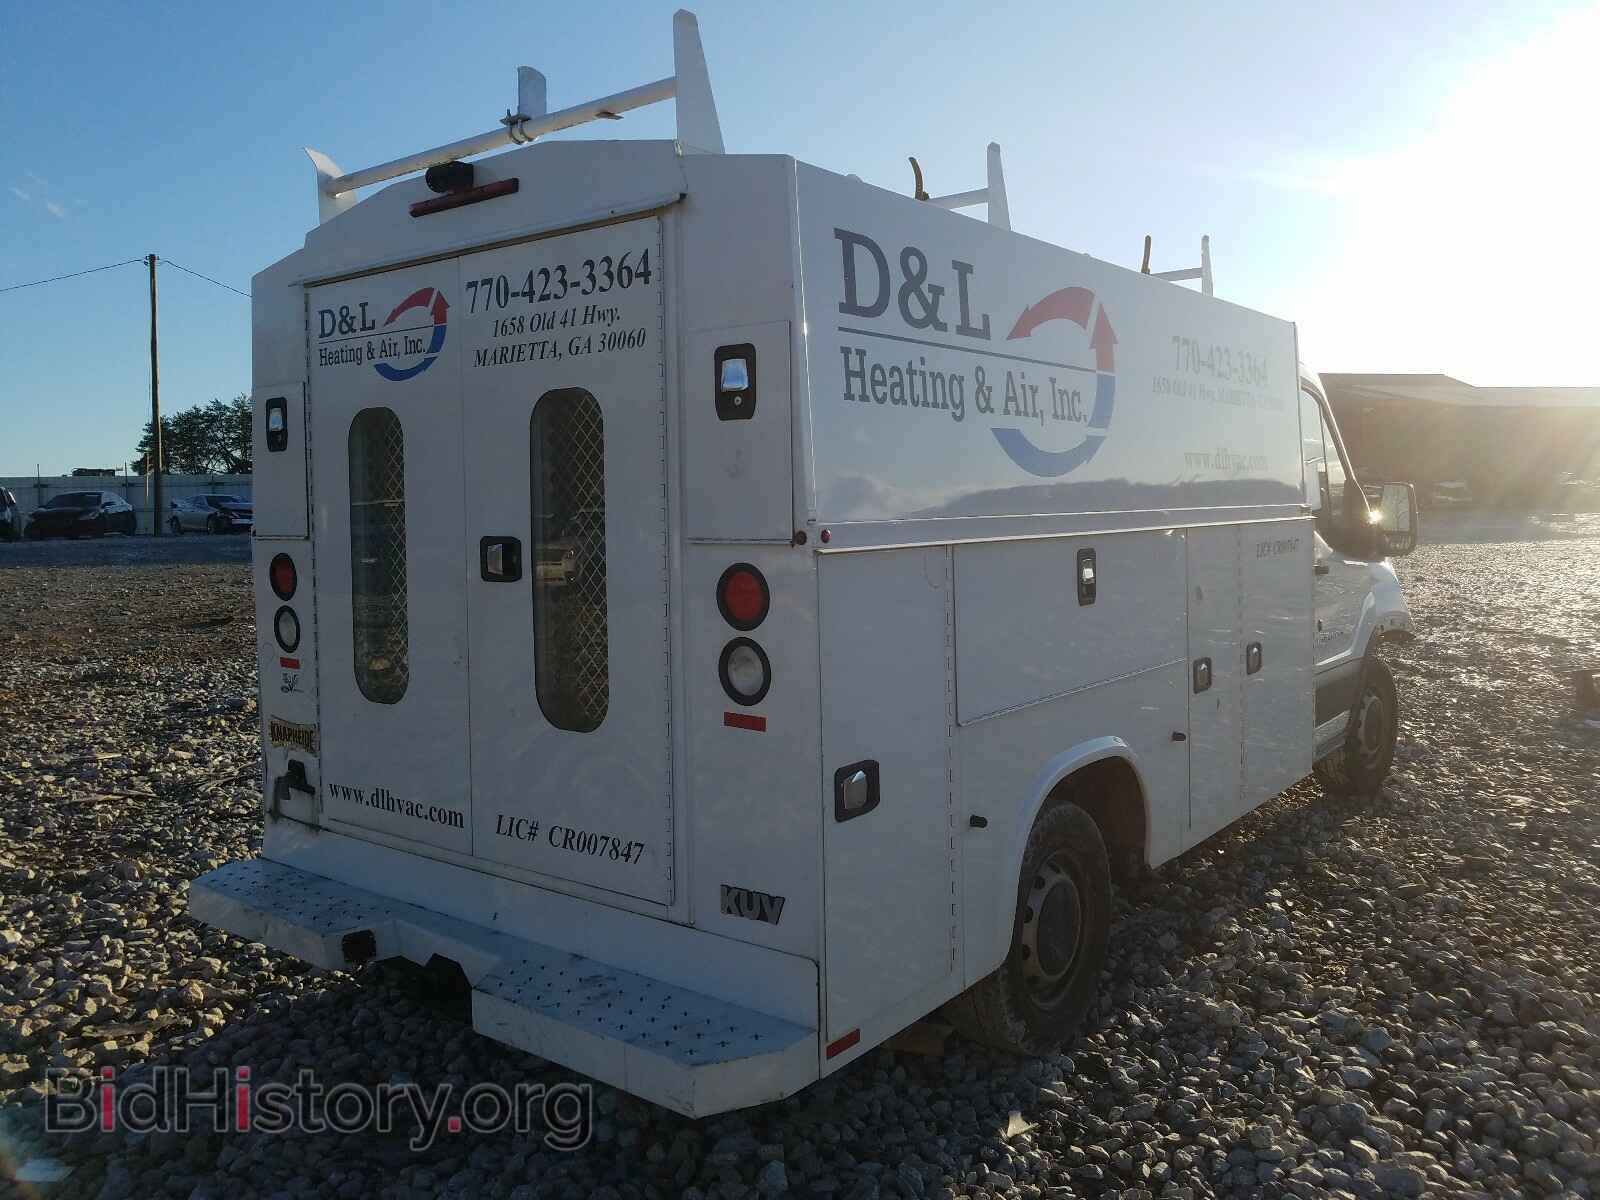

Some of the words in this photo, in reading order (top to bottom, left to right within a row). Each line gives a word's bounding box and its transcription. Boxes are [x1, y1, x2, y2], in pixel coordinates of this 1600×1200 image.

[465, 248, 652, 314] 770-423-3364
[834, 227, 991, 341] D&L
[318, 302, 375, 339] D&L
[492, 316, 524, 338] 1658
[530, 307, 555, 332] Old
[560, 310, 576, 328] 41
[582, 304, 621, 328] Hwy.
[319, 343, 363, 368] Heating
[366, 341, 375, 361] &
[403, 337, 426, 356] Inc.
[473, 340, 563, 368] MARIETTA,
[568, 335, 593, 356] GA
[598, 328, 647, 353] 30060
[840, 346, 965, 422] Heating
[974, 365, 994, 414] &
[1003, 370, 1045, 426] Air,
[1049, 377, 1088, 423] Inc.
[328, 783, 465, 828] www.dlhvac.com
[496, 814, 539, 841] LIC#
[548, 825, 645, 865] CR007847
[720, 884, 786, 926] KUV
